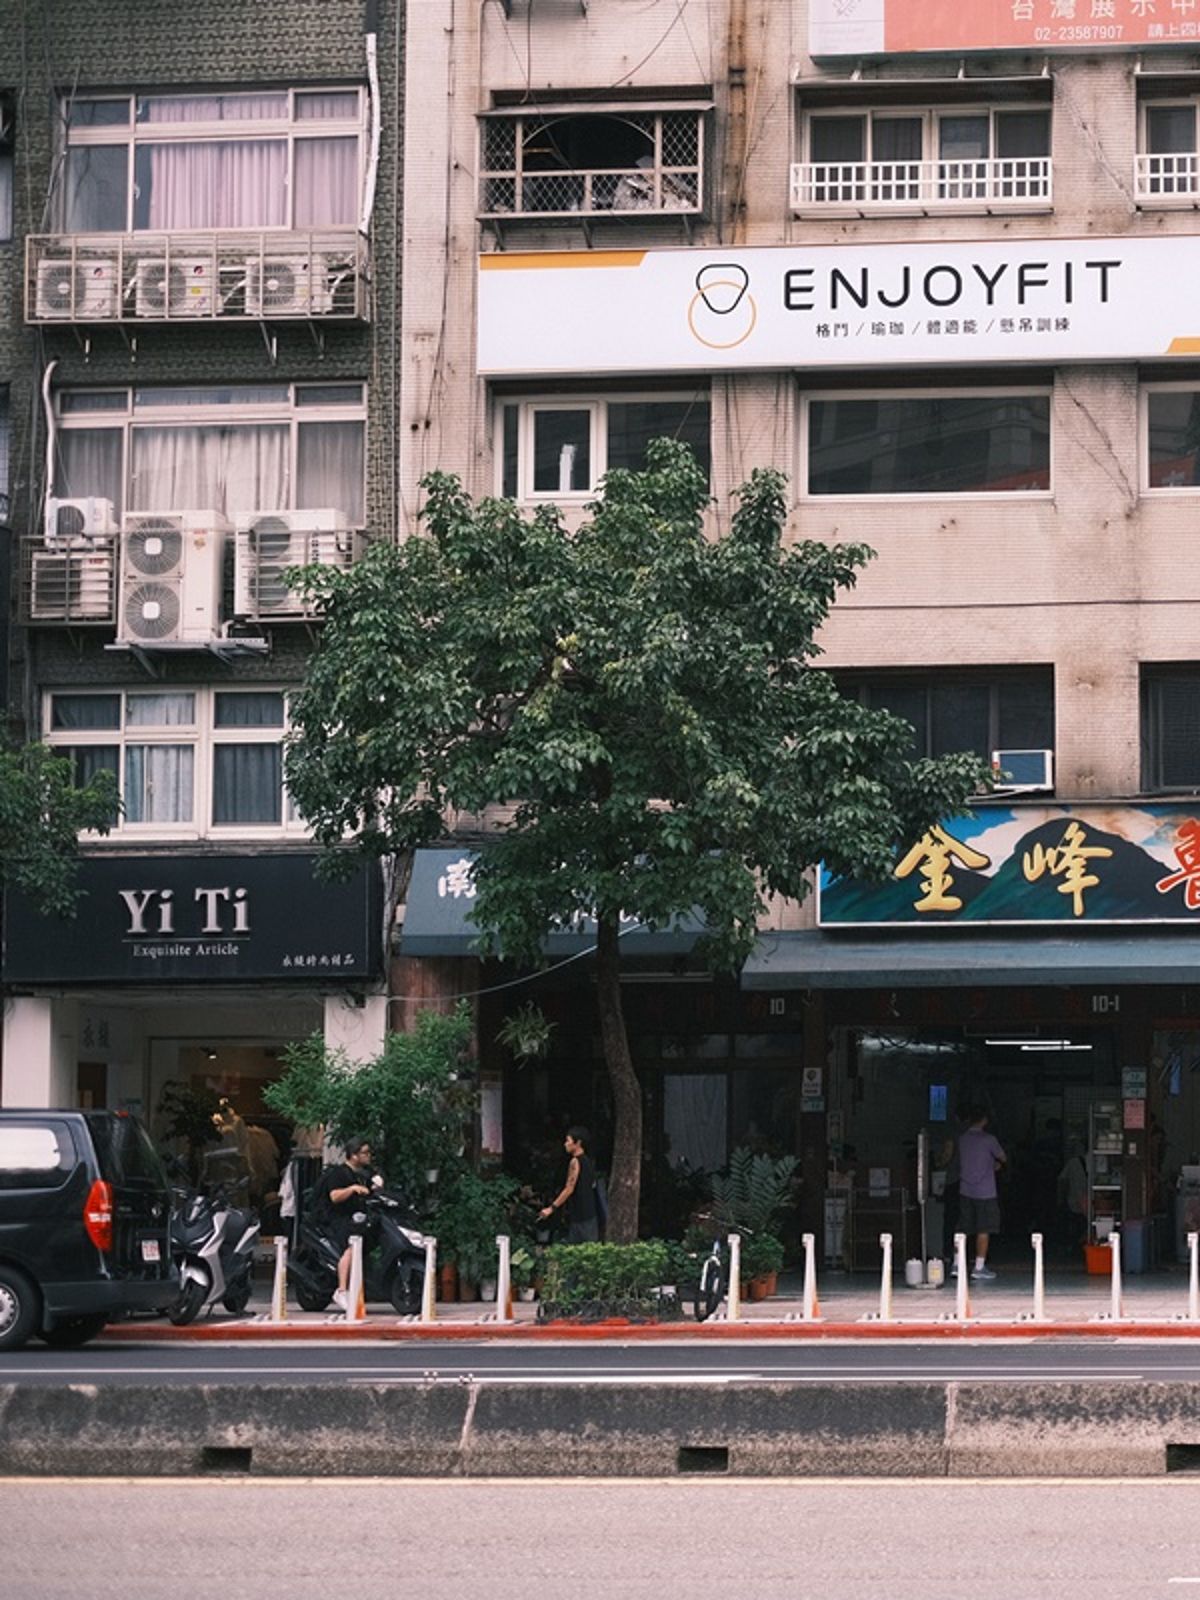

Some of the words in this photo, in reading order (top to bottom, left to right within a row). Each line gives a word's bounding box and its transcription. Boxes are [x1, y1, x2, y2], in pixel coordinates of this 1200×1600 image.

[1034, 26, 1124, 41] 02-23587907
[783, 260, 1122, 311] ENJOYFIT
[118, 888, 175, 933] Yi
[194, 886, 250, 932] Ti
[133, 944, 191, 959] Exquisite
[196, 943, 239, 956] Article
[770, 998, 785, 1015] 10
[1092, 995, 1119, 1012] 10-1
